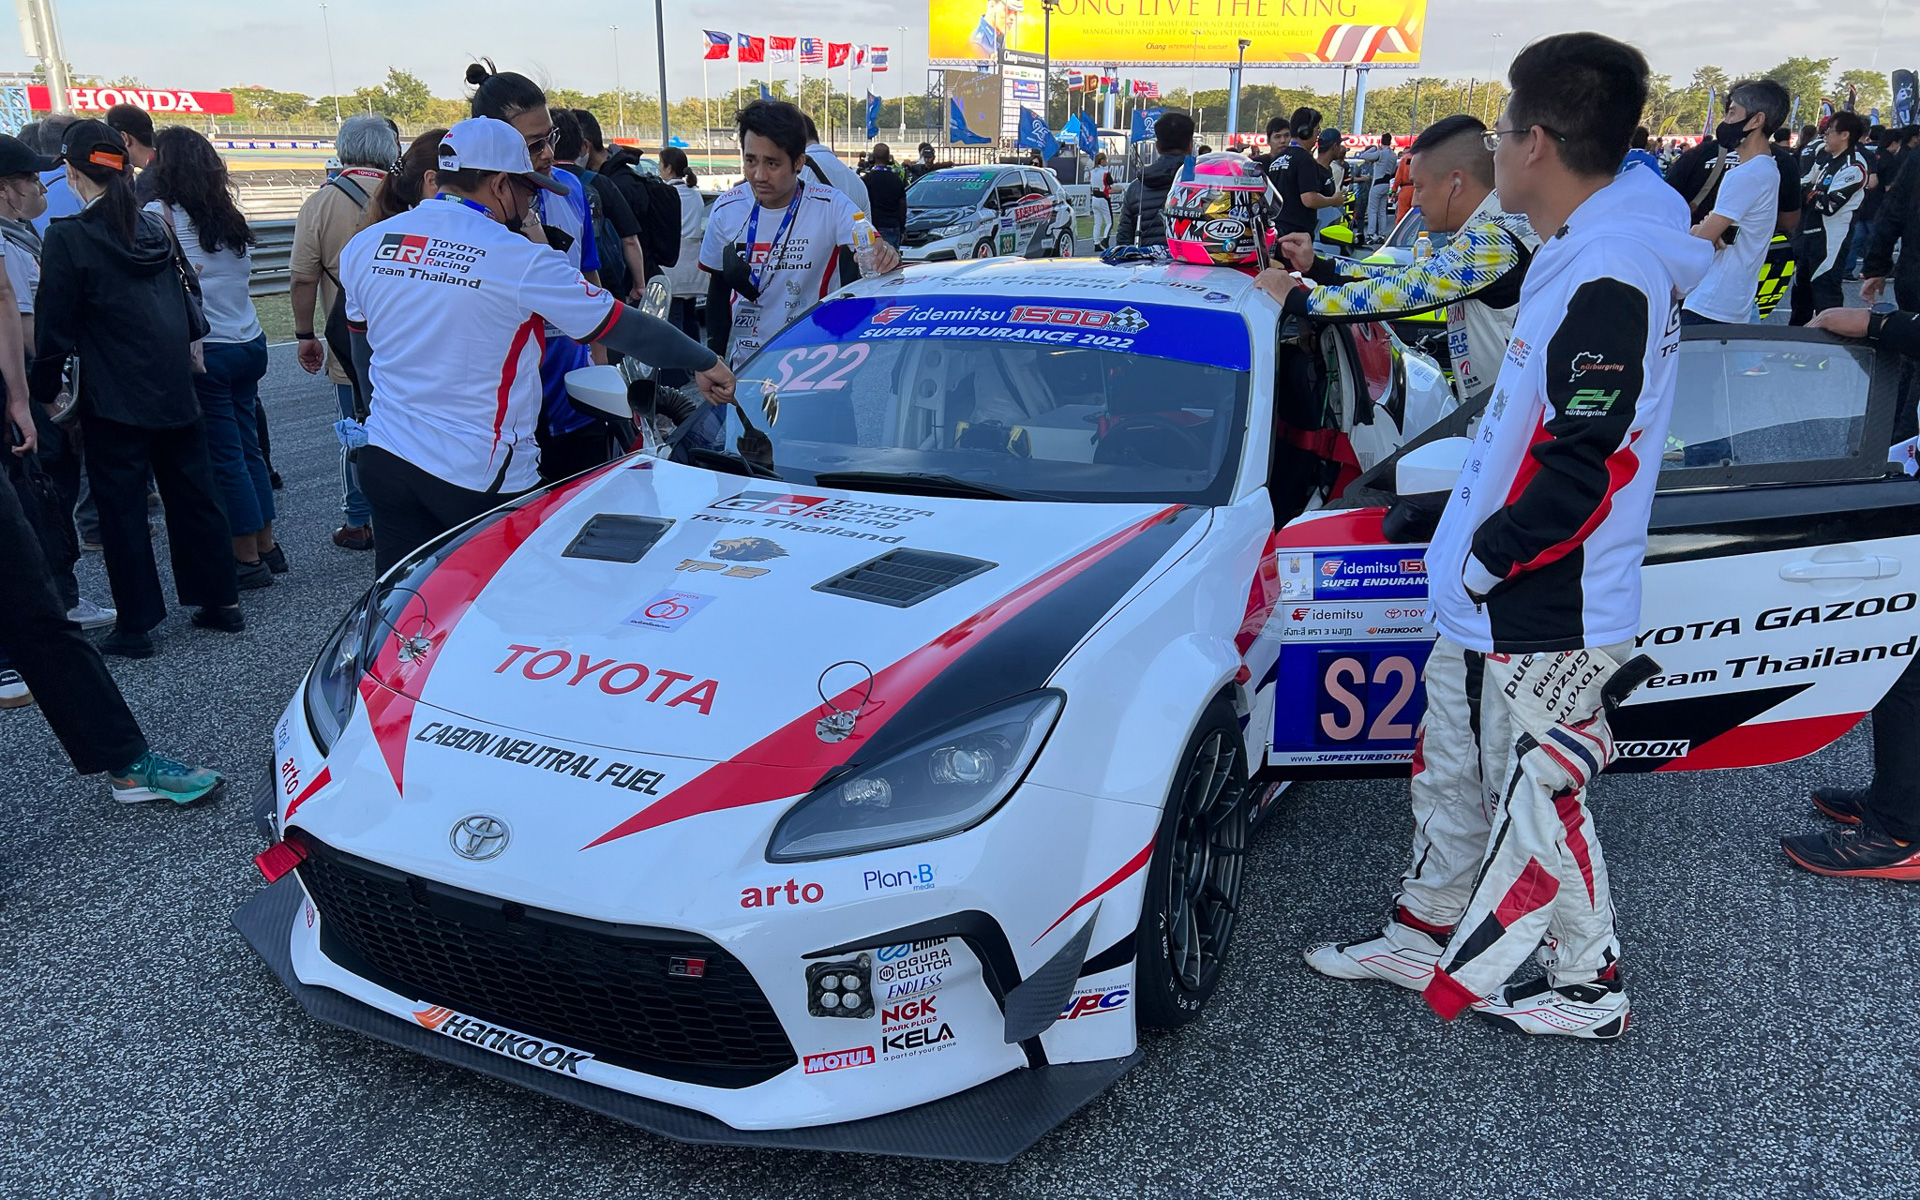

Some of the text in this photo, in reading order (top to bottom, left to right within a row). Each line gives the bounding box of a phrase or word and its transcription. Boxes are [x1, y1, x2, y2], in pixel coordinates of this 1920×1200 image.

[1044, 0, 1124, 15] ONG
[1281, 0, 1357, 17] KING
[63, 88, 203, 112] HONDA
[1207, 222, 1240, 234] Arai
[376, 243, 424, 265] GR
[427, 248, 477, 264] GAZOO
[431, 238, 487, 258] TOYOTA
[423, 257, 471, 274] Racing
[371, 265, 482, 290] Team Thailand
[734, 316, 755, 328] 220
[907, 305, 1112, 329] idemitsu 1500
[739, 339, 760, 348] KELA
[859, 326, 1135, 348] SUPER ENDURANCE 2022
[1661, 342, 1680, 358] Te
[760, 342, 871, 394] S22
[1566, 388, 1622, 411] 24
[711, 497, 810, 516] GR
[815, 504, 916, 522] GAZOO
[832, 499, 936, 518] TOYOTA
[689, 513, 907, 545] Team Thailand
[801, 511, 900, 530] Racing
[1343, 561, 1398, 575] idemitsu
[1321, 577, 1430, 588] SUPER ENDURANC
[1312, 609, 1426, 620] idemitsu TOY
[1634, 592, 1918, 648] YOTA GAZOO
[1645, 635, 1919, 690] eam Thailand
[494, 643, 720, 717] TOYOTA
[1320, 655, 1428, 741] S2
[414, 721, 667, 797] CABON NEUTRAL FUEL
[1614, 741, 1688, 757] KOOK
[740, 877, 824, 909] arto
[913, 882, 935, 892] media
[896, 948, 950, 969] OGURA
[897, 957, 953, 980] CLUTCH
[670, 963, 705, 976] GR
[887, 972, 943, 999] ENDLESS
[1073, 982, 1131, 996] RFACE TREATMENT
[881, 994, 937, 1026] NGK
[882, 1015, 938, 1034] SPARK PLUGS
[882, 1022, 955, 1054] KELA
[807, 1048, 872, 1073] MOTUL
[890, 1052, 907, 1061] part
[918, 1046, 936, 1055] your
[936, 1041, 957, 1052] game
